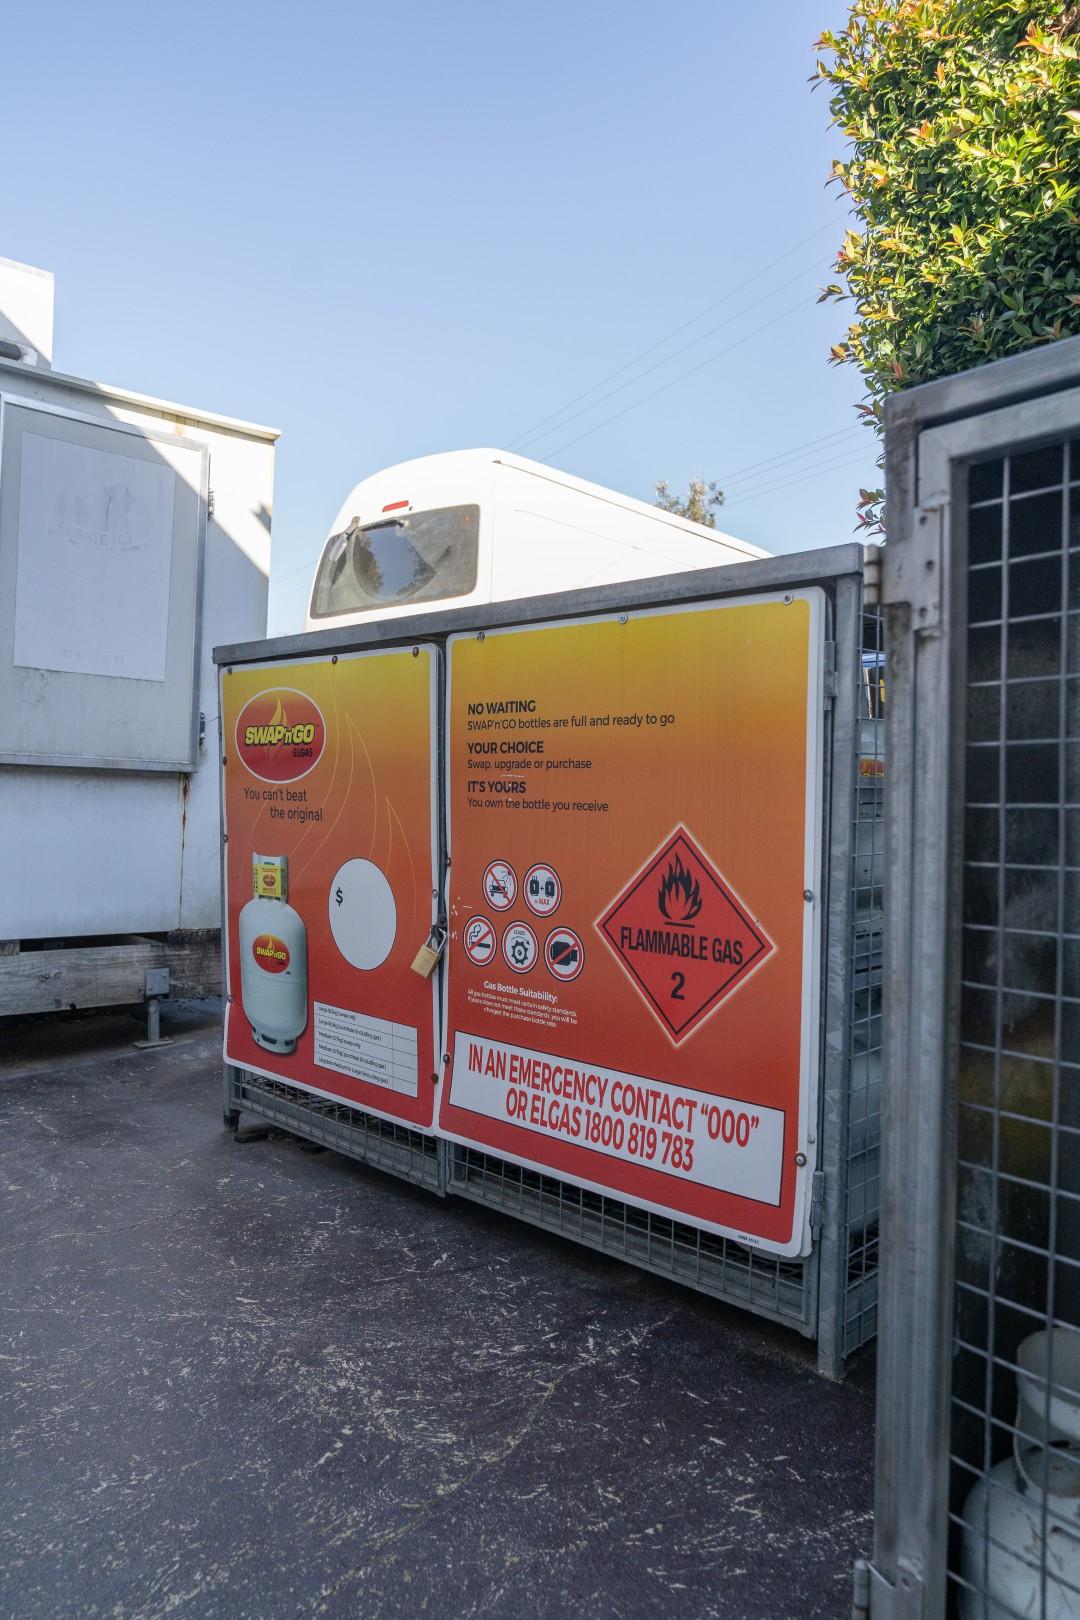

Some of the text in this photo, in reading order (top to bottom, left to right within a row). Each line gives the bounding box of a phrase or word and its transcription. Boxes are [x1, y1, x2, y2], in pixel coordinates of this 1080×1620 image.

[468, 699, 537, 715] NO WAITING
[518, 717, 551, 729] bottles
[553, 718, 569, 728] are
[571, 715, 587, 727] full
[589, 714, 610, 726] and
[612, 713, 643, 728] ready
[646, 714, 658, 725] to
[660, 714, 675, 727] go
[467, 740, 544, 754] YOUR CHOICE
[494, 758, 532, 771] upgrade
[534, 759, 543, 769] or
[546, 758, 592, 771] purchase
[244, 787, 307, 802] You can't beat
[467, 781, 526, 794] IT'S YOURS
[468, 797, 609, 813] You own the bottle you receive
[270, 807, 323, 823] the original
[335, 886, 344, 907] $
[620, 926, 744, 966] FLAMMABLE GAS
[484, 980, 558, 1004] Gas Bottle Suitability:
[671, 971, 686, 1000] 2
[468, 1043, 483, 1072] IN
[485, 1049, 507, 1081] AN
[509, 1054, 609, 1109] EMERGENCY
[610, 1081, 697, 1133] CONTACT
[506, 1087, 694, 1173] OR ELGAS 1800 819 783
